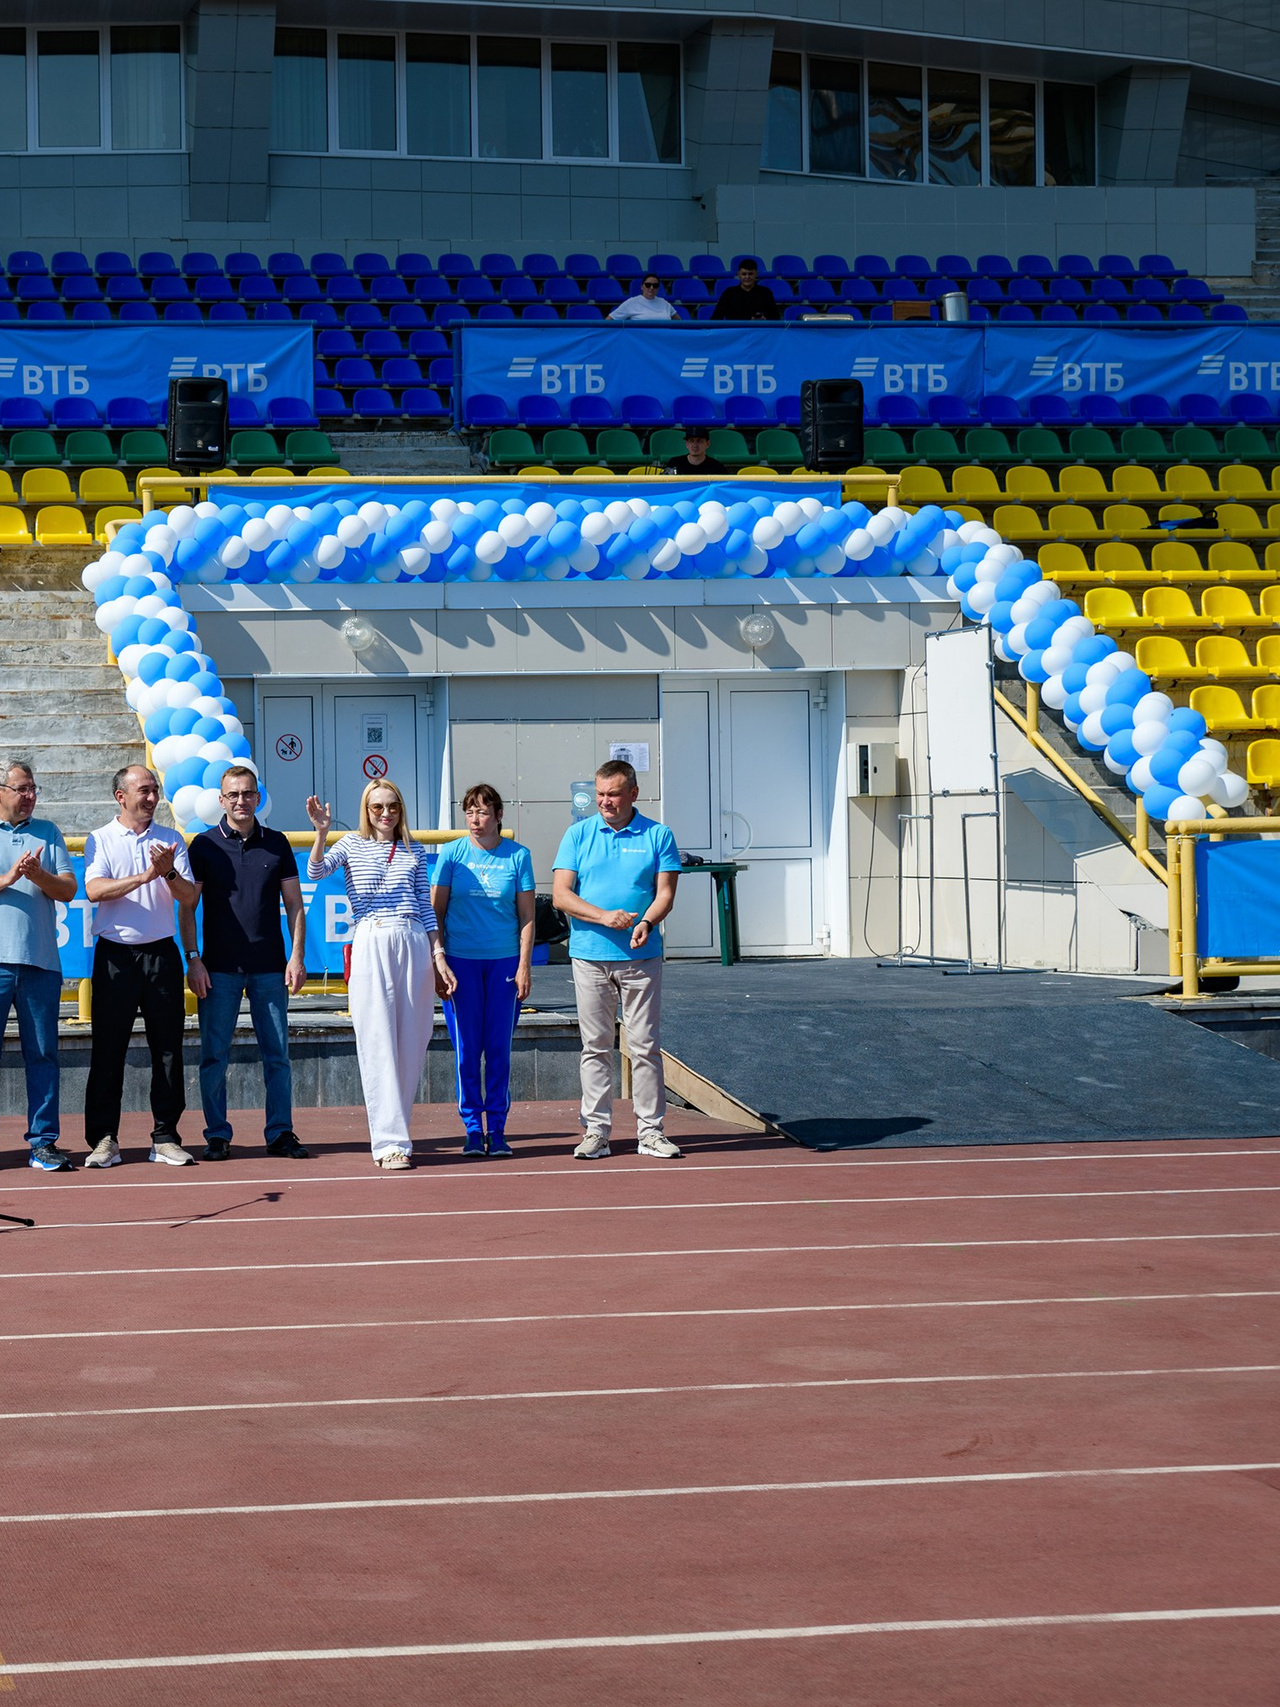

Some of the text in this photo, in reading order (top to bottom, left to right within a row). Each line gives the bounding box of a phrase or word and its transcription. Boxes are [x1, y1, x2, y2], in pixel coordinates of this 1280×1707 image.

[22, 364, 90, 395] ВТБ
[540, 363, 606, 394] ВТБ
[713, 364, 777, 394] ВТБ
[883, 363, 948, 393] ВТБ
[1062, 362, 1125, 392] ВТБ
